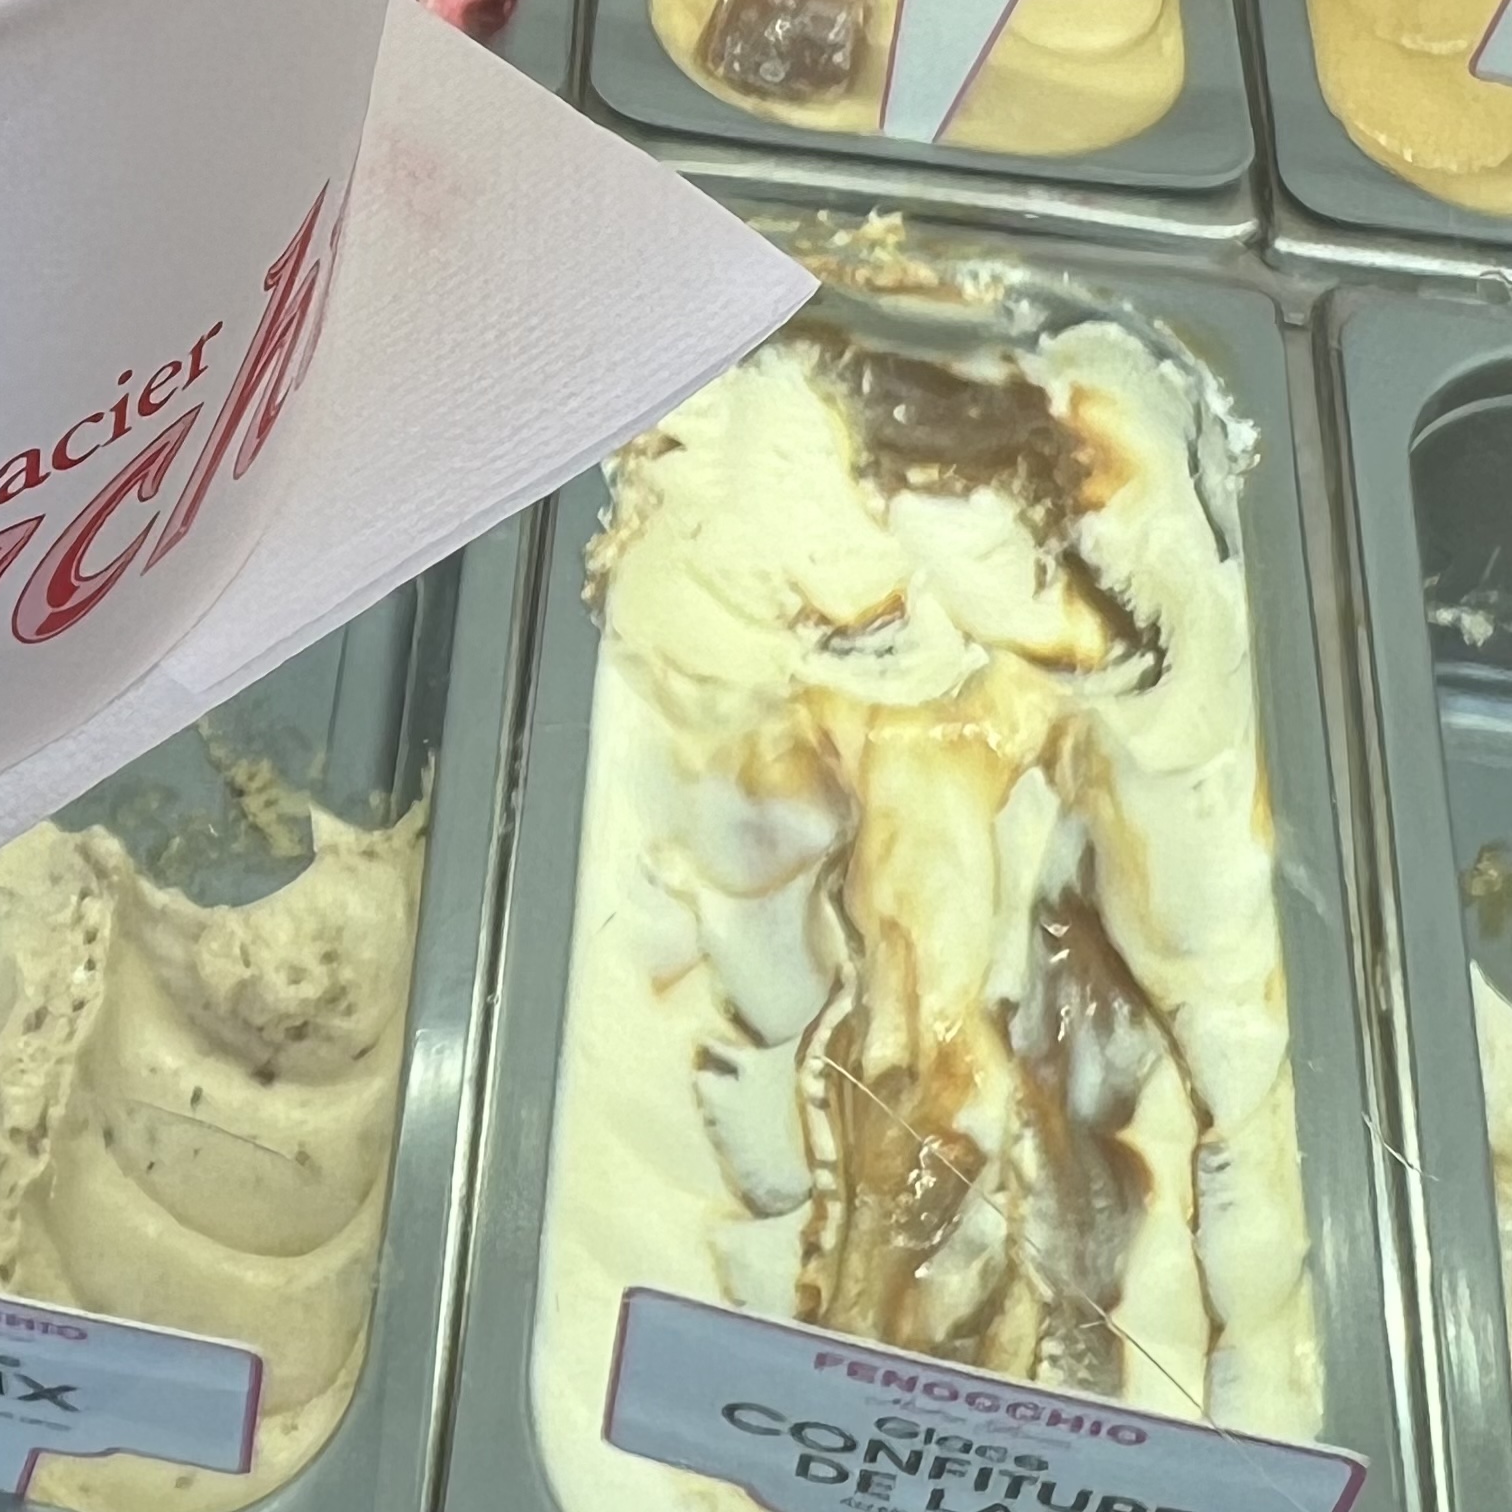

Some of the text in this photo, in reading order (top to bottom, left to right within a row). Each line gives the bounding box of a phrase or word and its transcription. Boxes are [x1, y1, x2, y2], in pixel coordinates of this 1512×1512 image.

[813, 1351, 1148, 1446] FENOCCHIO
[720, 1401, 1194, 1512] CONFITUR
[794, 1452, 897, 1500] DE
